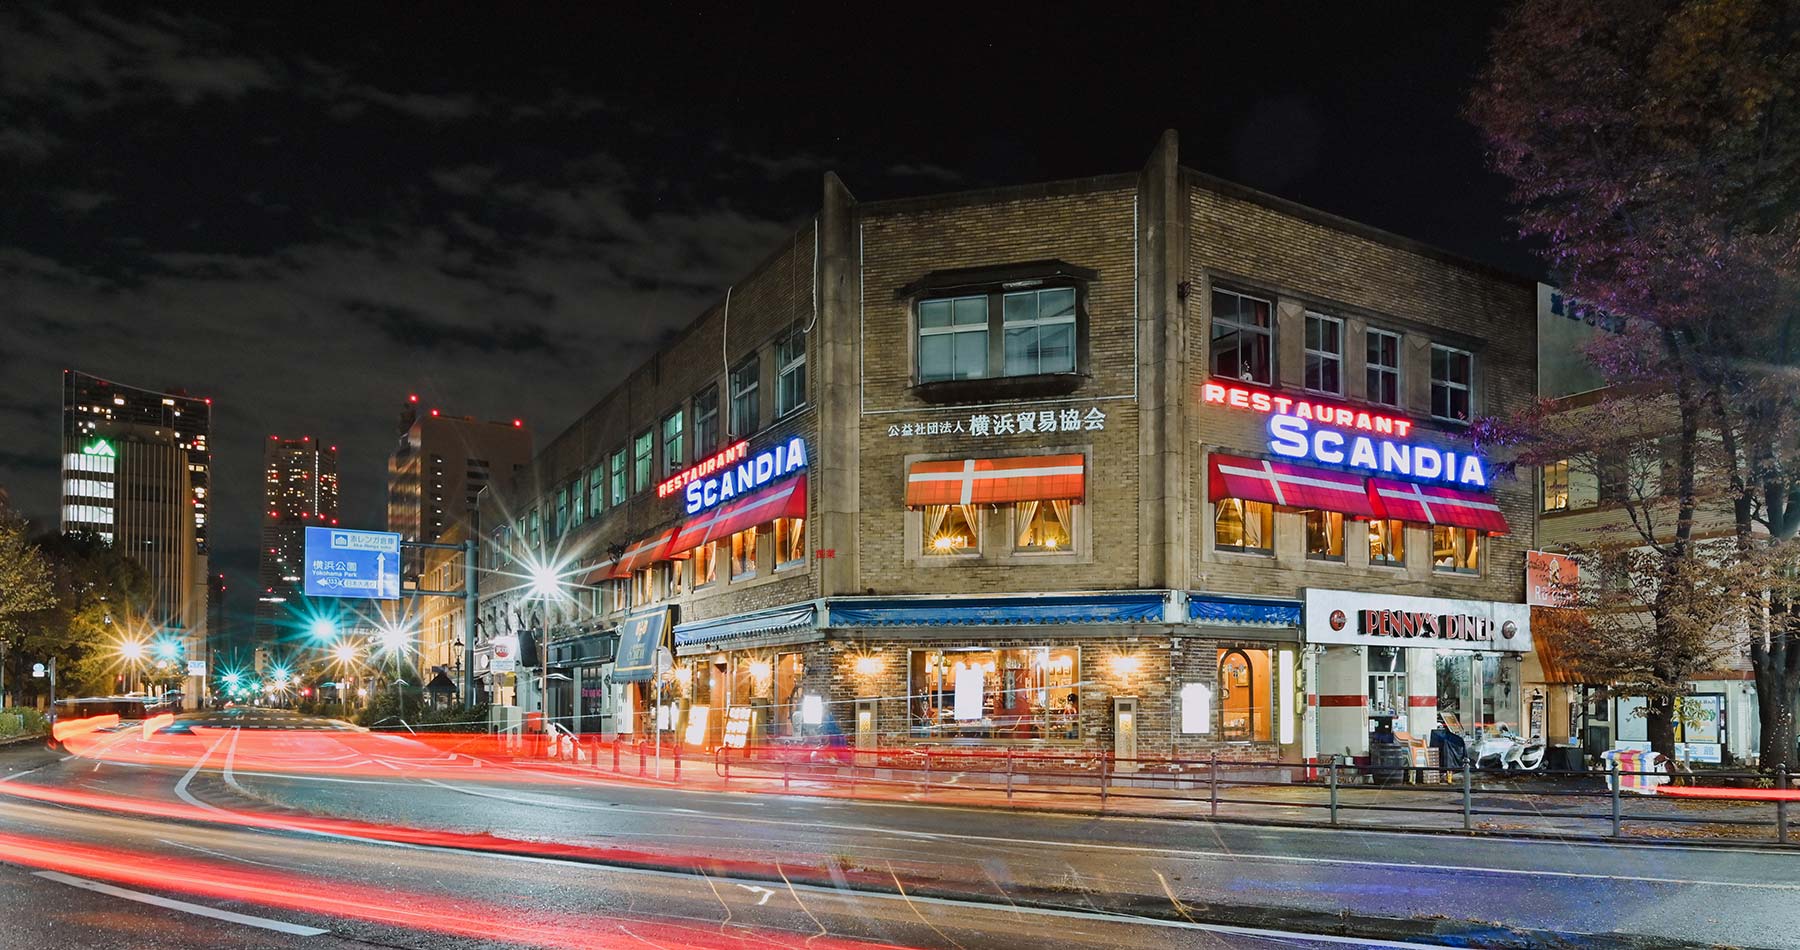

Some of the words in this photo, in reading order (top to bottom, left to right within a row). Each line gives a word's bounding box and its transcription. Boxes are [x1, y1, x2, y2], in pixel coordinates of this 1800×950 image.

[888, 421, 965, 437] 公益社団法人
[969, 407, 1106, 437] 横浜貿易協会
[1204, 383, 1411, 437] RESTAURANT
[658, 440, 748, 497] RESTAURANT
[1270, 414, 1486, 486] SCANDIA
[686, 437, 807, 514] SCANDIA
[312, 569, 342, 577] Yokohama
[313, 560, 357, 572] 横浜公園
[1360, 609, 1439, 638] PENNY'S
[1443, 613, 1497, 641] DINER
